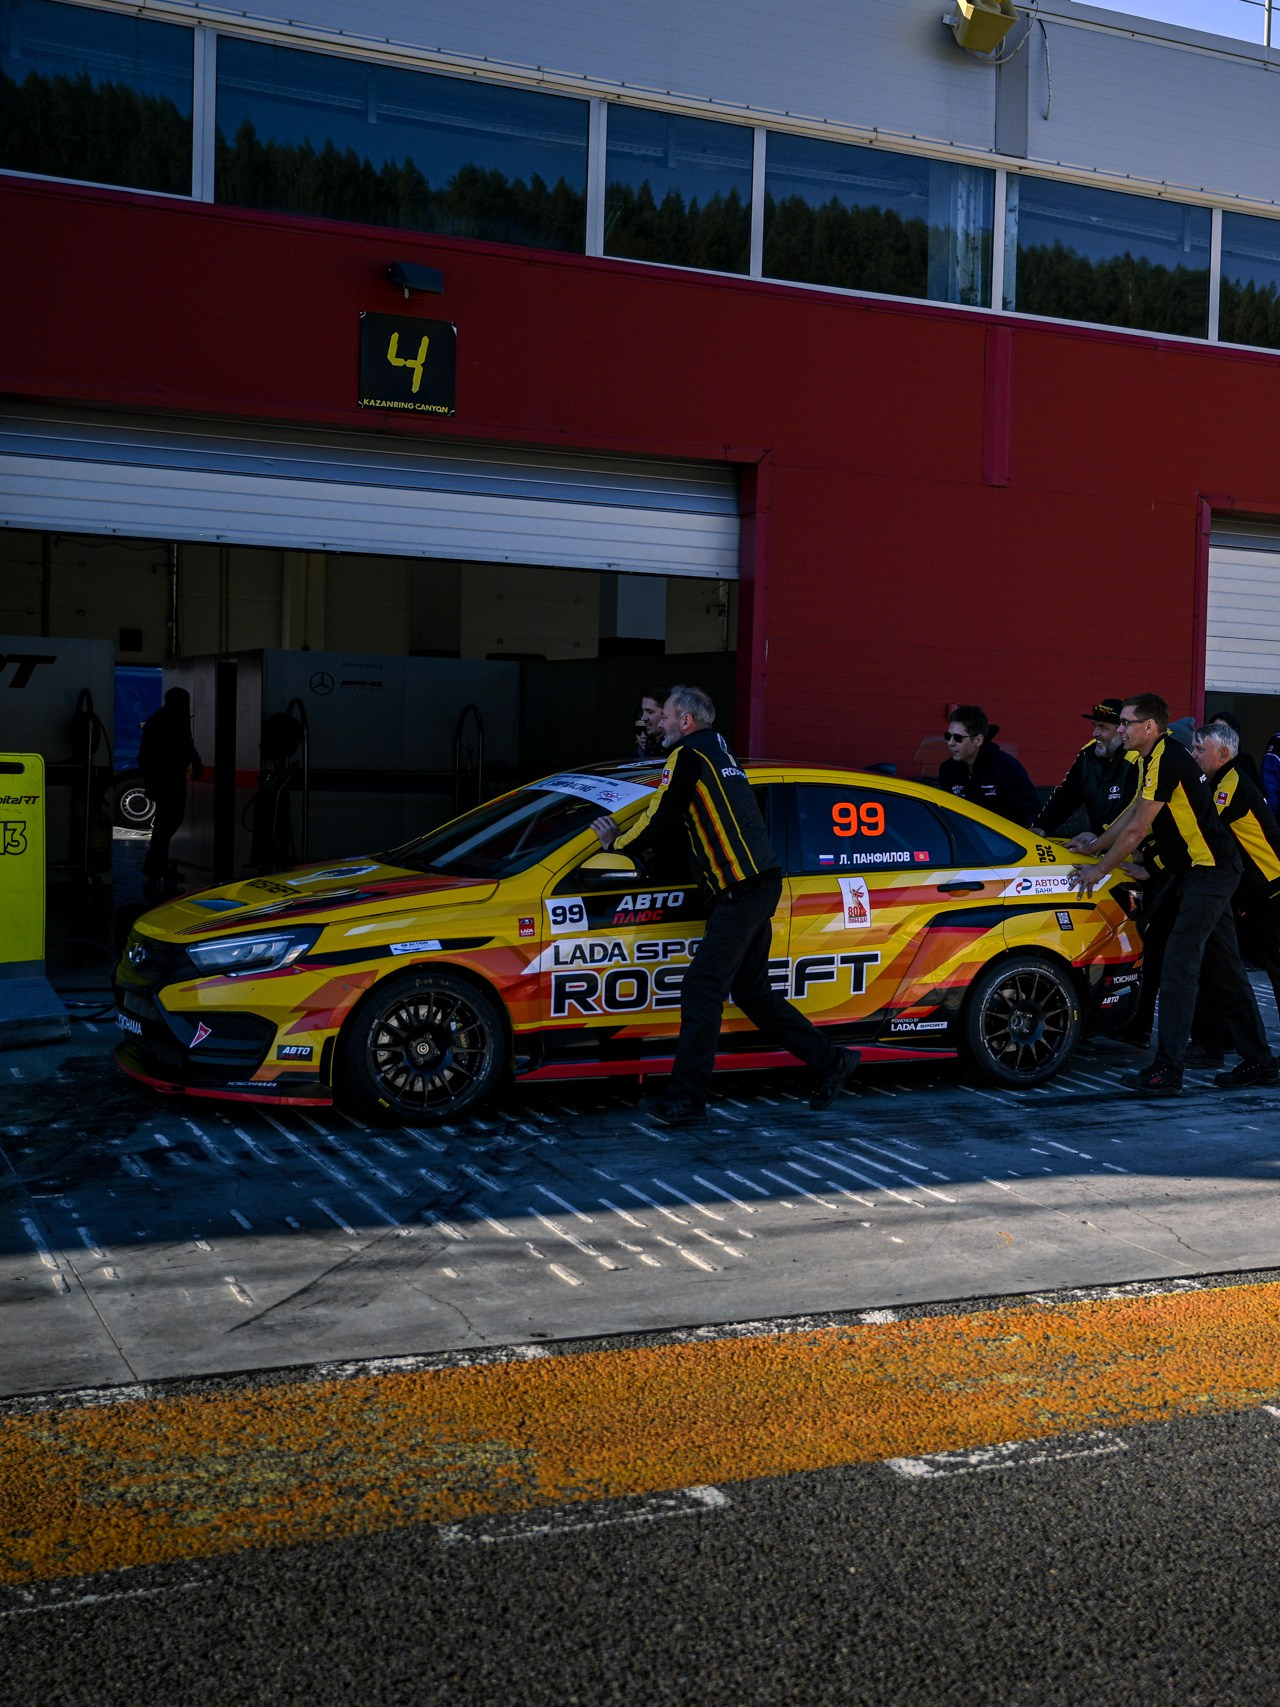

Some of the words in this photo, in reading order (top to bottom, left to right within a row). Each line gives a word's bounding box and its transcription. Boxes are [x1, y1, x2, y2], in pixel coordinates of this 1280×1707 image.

[387, 332, 430, 394] 4
[363, 398, 414, 410] KAZANRING
[415, 403, 449, 414] CANYON
[832, 802, 886, 838] 99
[839, 854, 850, 864] Л.
[853, 852, 910, 864] ПАНФИЛОВ
[616, 891, 685, 912] АВТО
[551, 904, 584, 926] 99
[612, 910, 664, 926] ПЛЮС
[552, 941, 630, 968] LADA
[550, 950, 880, 1017] ROSEFT
[1113, 974, 1138, 984] YOKOHAMA
[1102, 996, 1120, 1004] АВТО
[891, 1023, 916, 1032] LADA
[282, 1046, 310, 1056] АВТО
